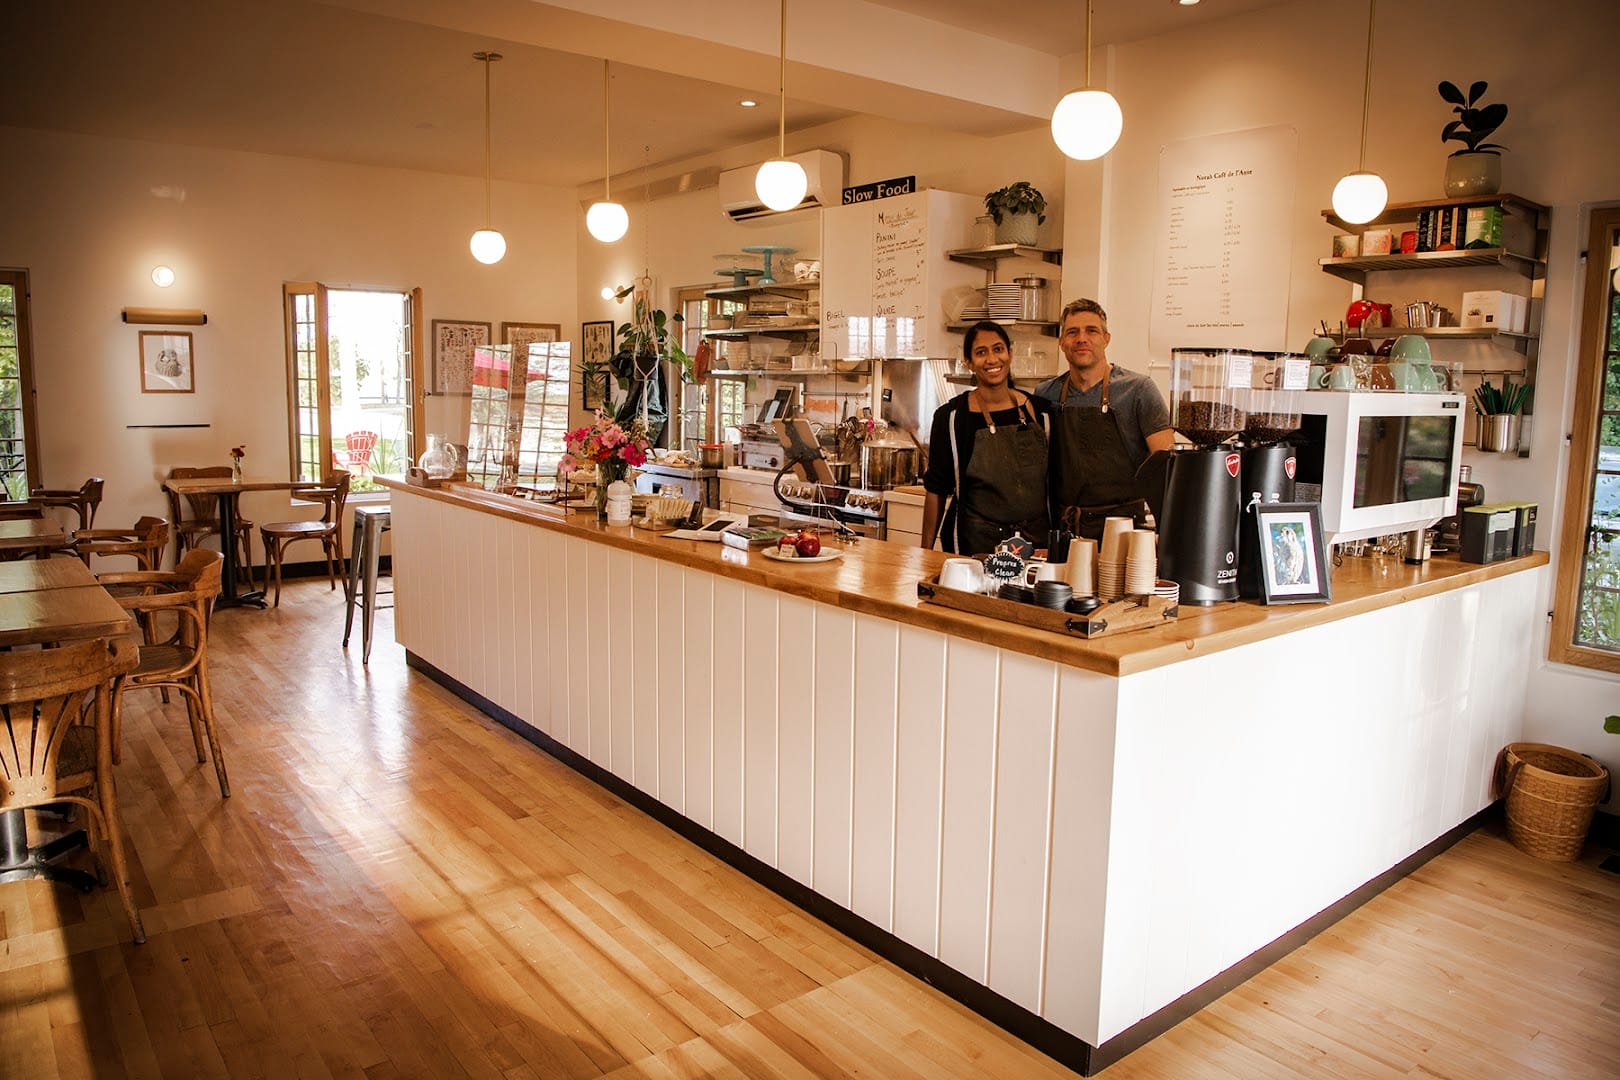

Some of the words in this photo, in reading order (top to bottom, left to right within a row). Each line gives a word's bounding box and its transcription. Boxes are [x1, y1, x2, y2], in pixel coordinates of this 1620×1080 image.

[843, 188, 873, 204] Slow
[877, 179, 910, 199] Food
[876, 232, 896, 243] PANINI
[875, 267, 897, 280] SOUPE
[994, 568, 1015, 577] Clean
